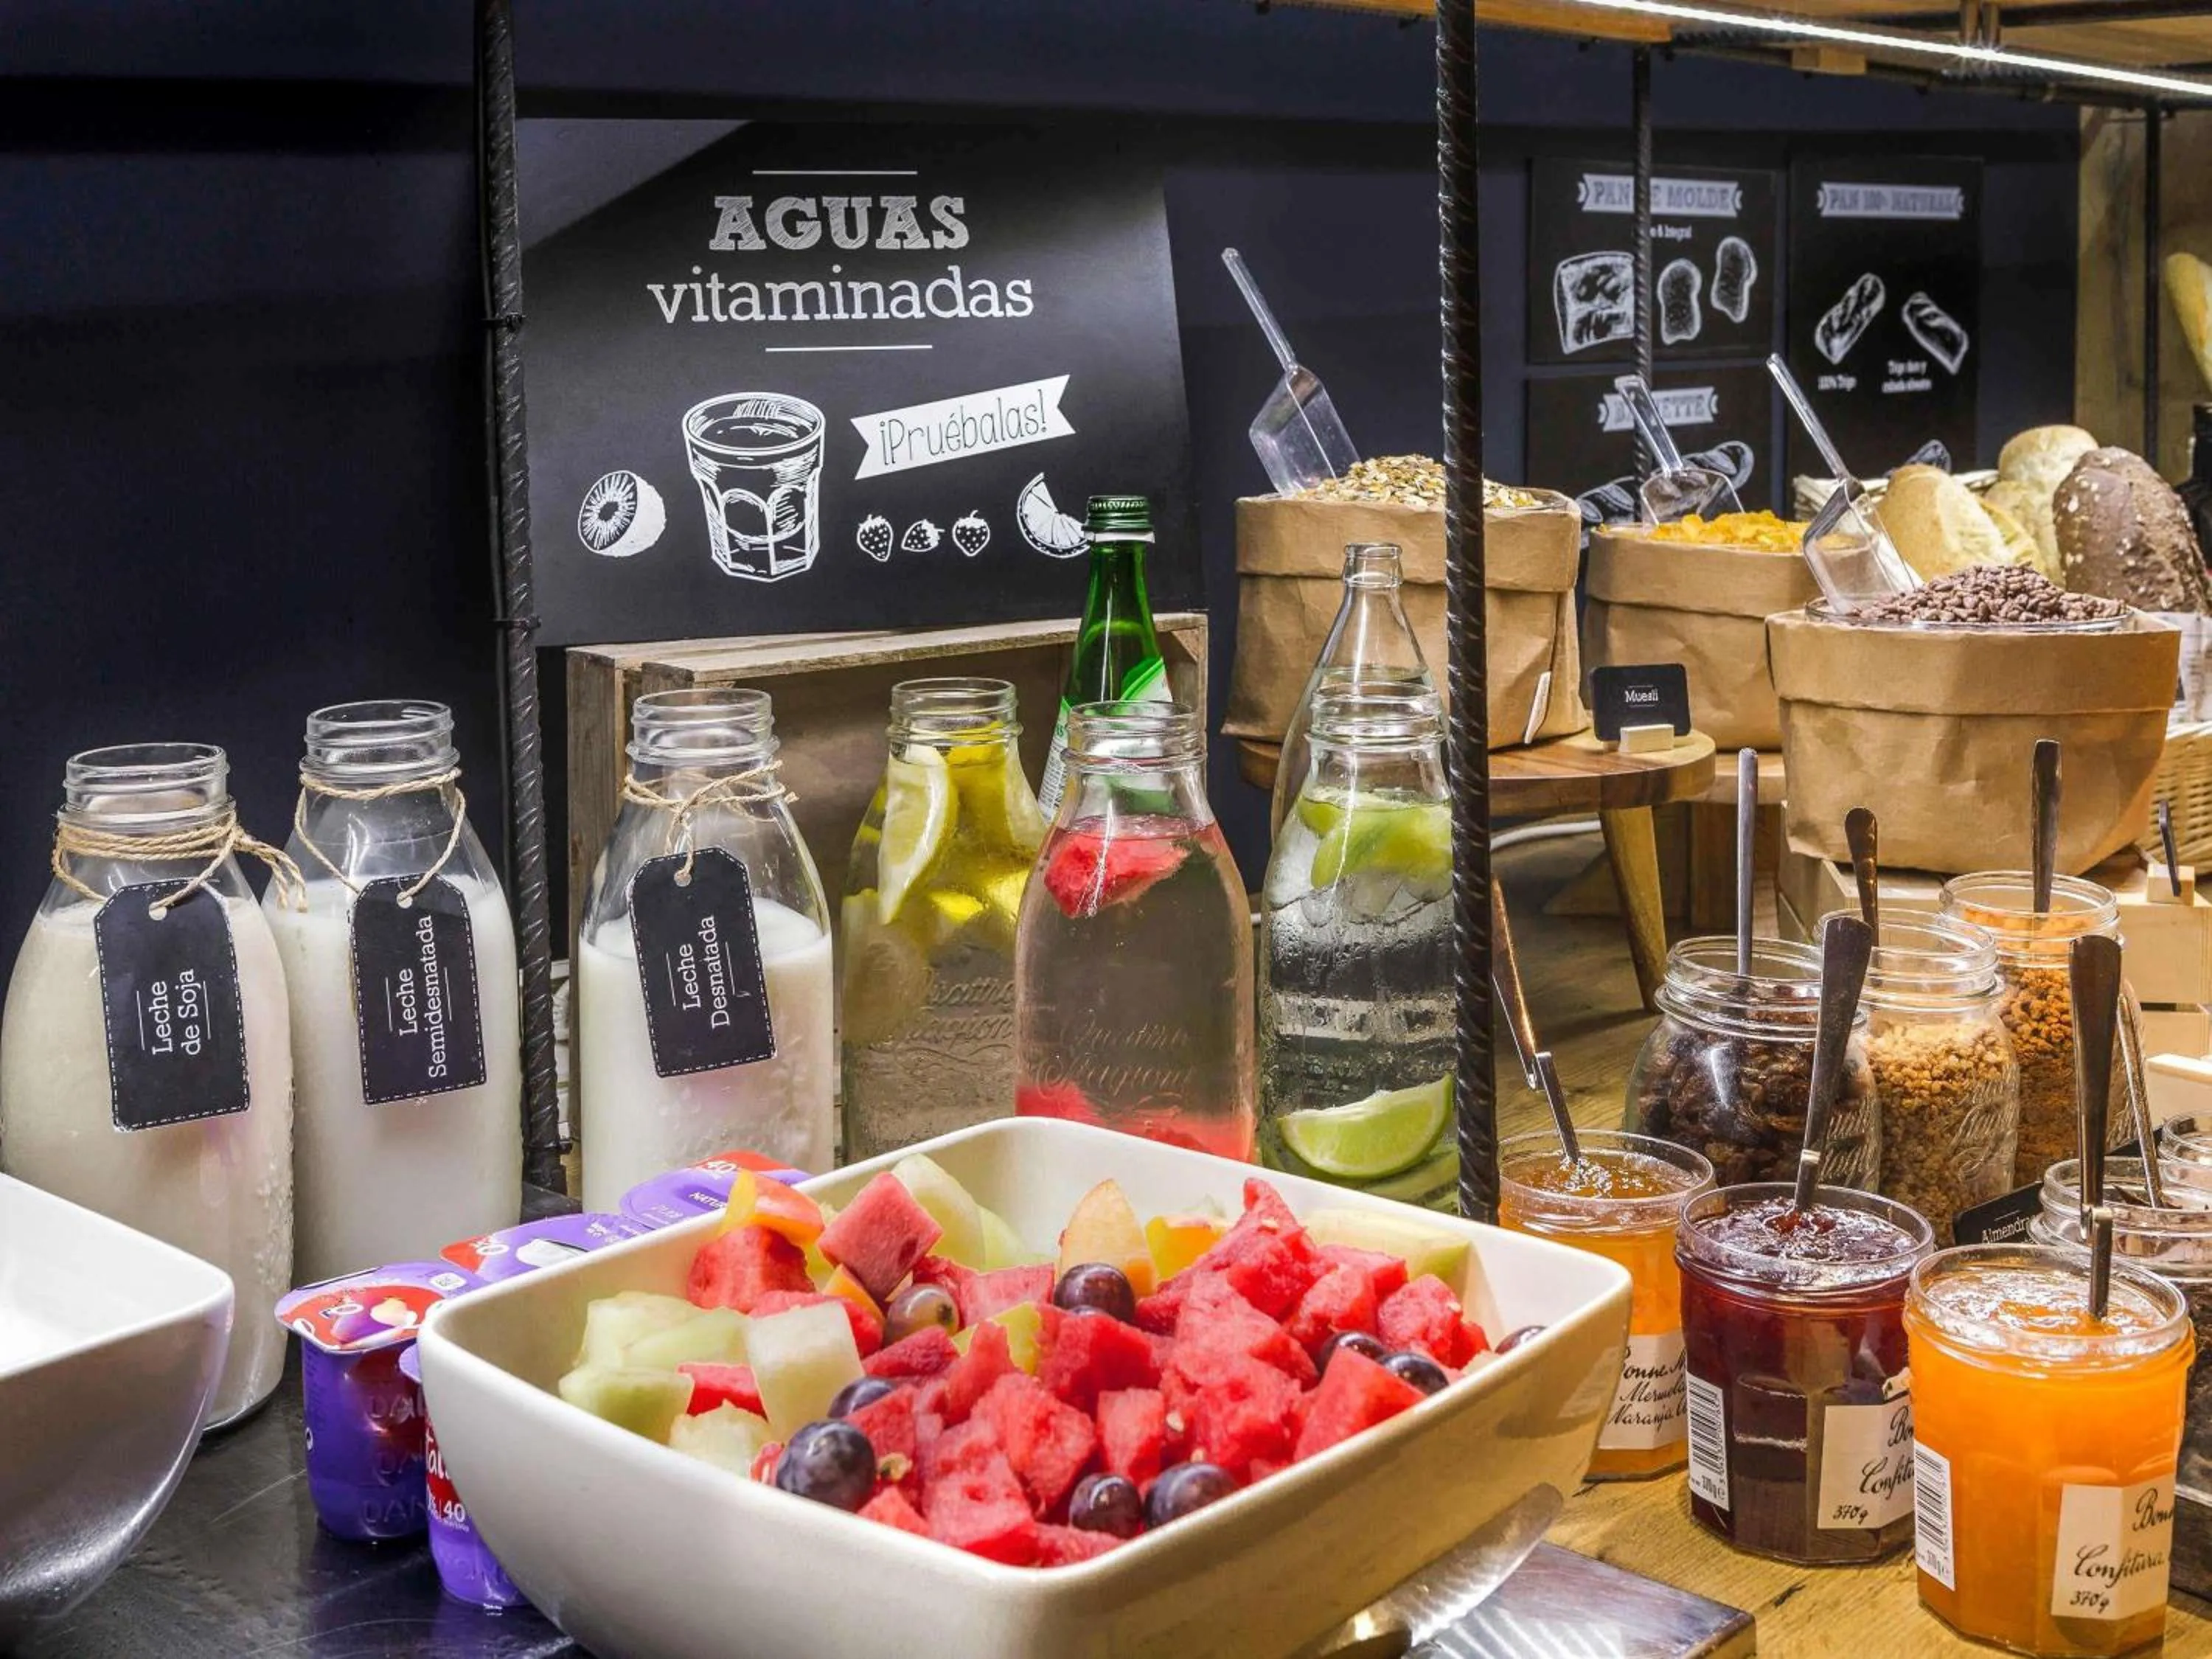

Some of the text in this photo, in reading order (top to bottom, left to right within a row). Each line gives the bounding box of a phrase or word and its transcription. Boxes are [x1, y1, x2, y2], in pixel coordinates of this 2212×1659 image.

[709, 195, 970, 251] AGUAS
[1593, 181, 1632, 206] PAN
[1666, 185, 1731, 211] MOLDE
[647, 264, 1034, 324] vitaminadas
[880, 389, 1048, 467] ¡Pruébalas!
[1624, 688, 1659, 703] Muesli
[396, 967, 420, 1036] Leche
[415, 914, 448, 1078] Semidesnatada
[677, 942, 701, 1012] Leche
[698, 914, 731, 1030] Desnatada
[148, 980, 174, 1056] Leche
[177, 969, 206, 1056] de Soja
[443, 1502, 465, 1530] 40
[2074, 1543, 2166, 1589] Confitura
